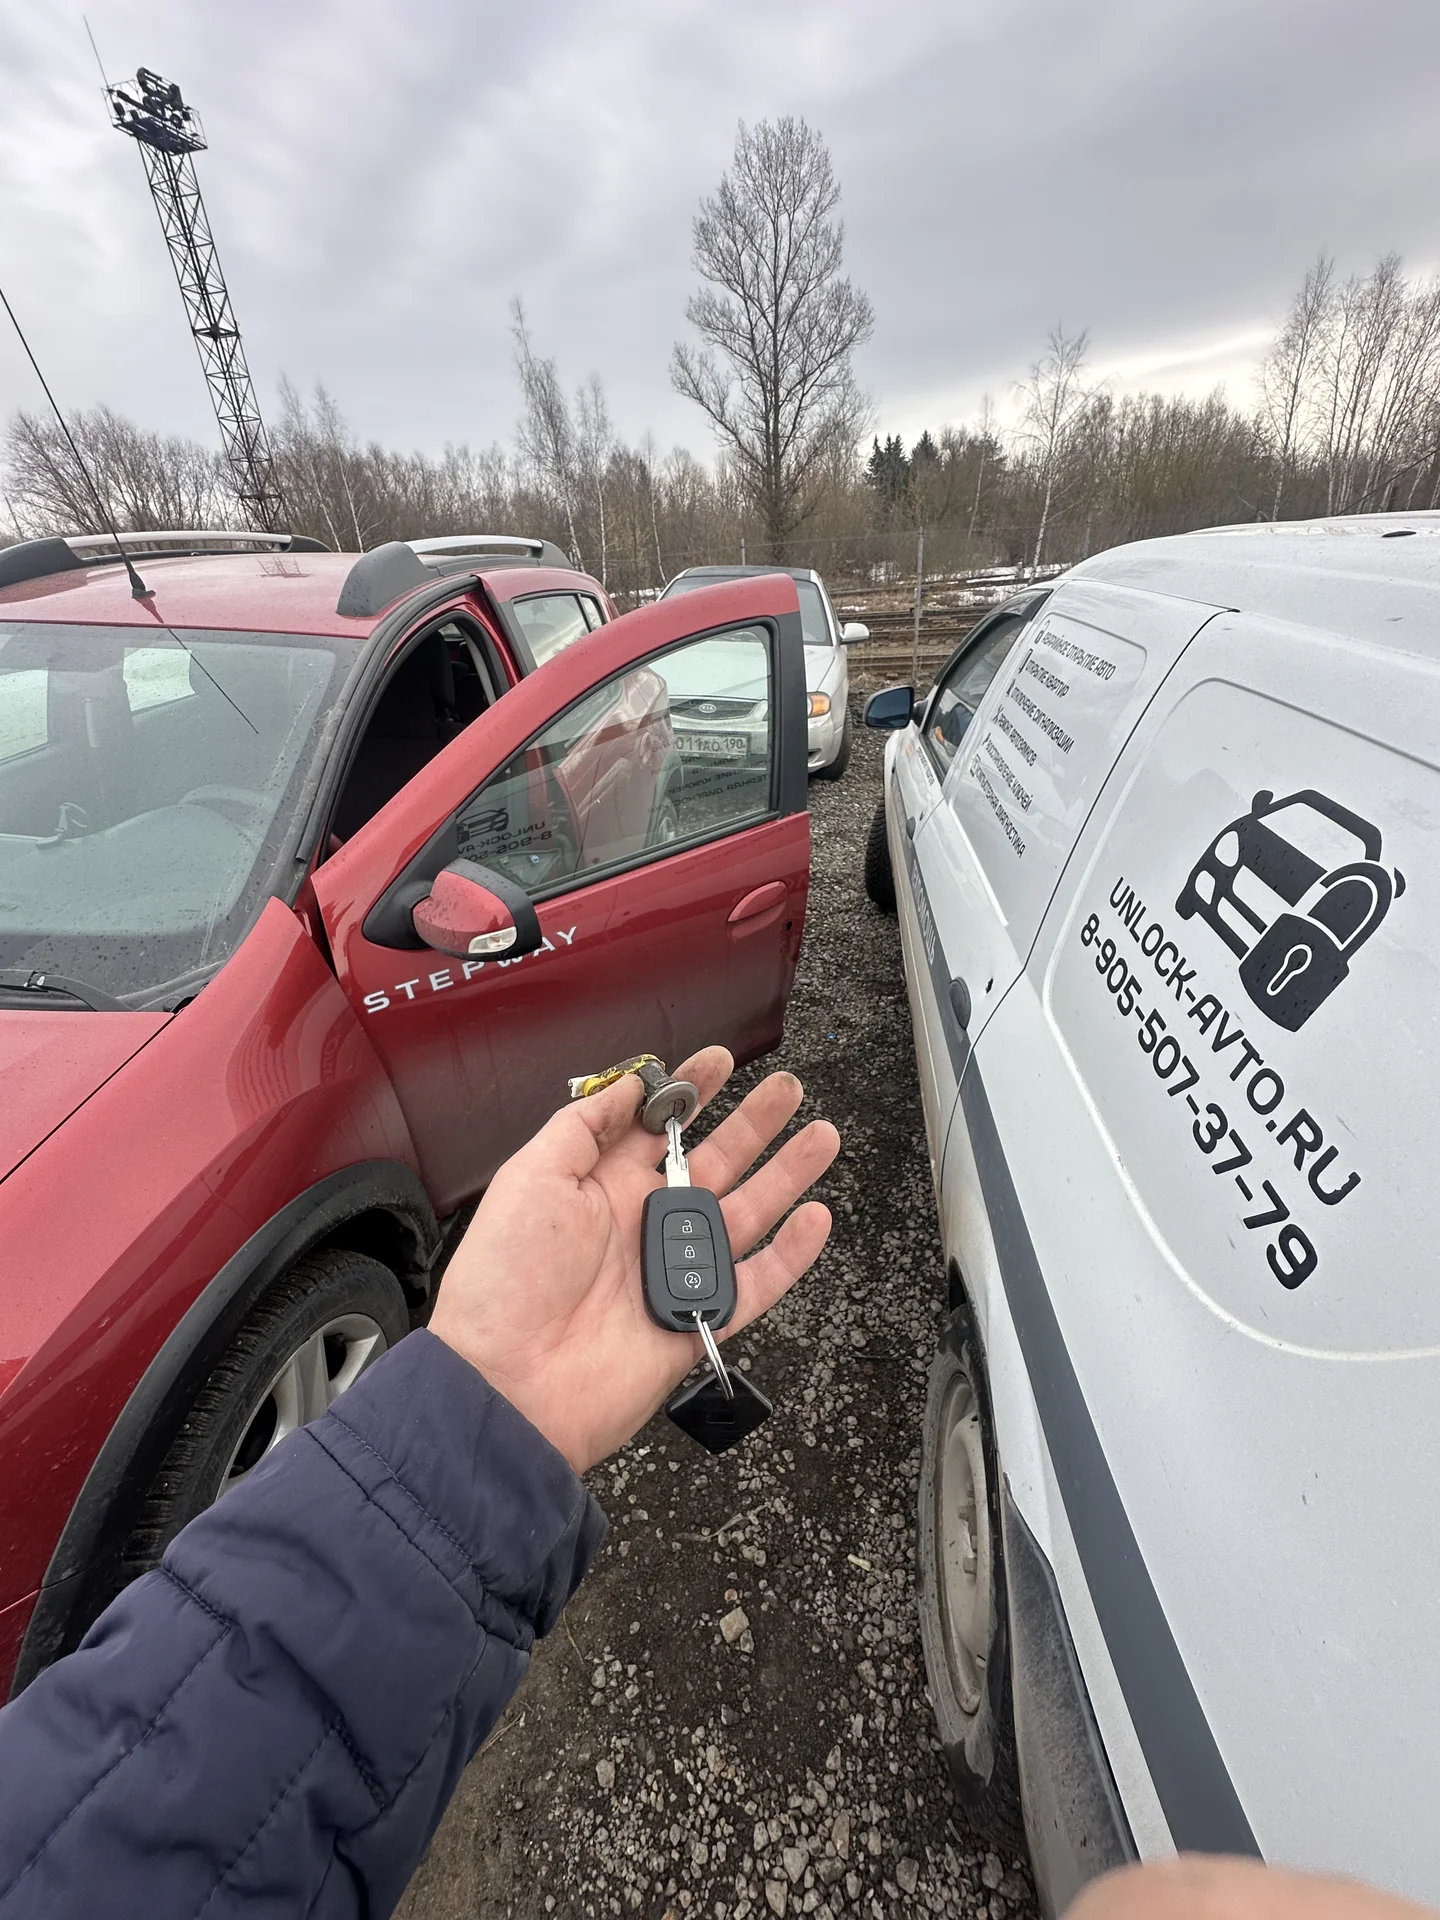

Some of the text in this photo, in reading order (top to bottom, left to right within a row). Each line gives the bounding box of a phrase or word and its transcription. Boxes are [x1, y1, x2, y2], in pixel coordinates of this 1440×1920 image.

[1025, 659, 1070, 698] ОТКРЫТИЕ КВАРТИР
[1065, 644, 1099, 672] ОТКРЫТИЕ
[1092, 659, 1116, 681] АВТО
[1010, 687, 1075, 754] ОТКЛЮЧЕНИЕ СИГНАЛИЗАЦИИ
[723, 738, 743, 749] 190
[1009, 728, 1037, 767] АВТОЗАМКОВ
[1011, 779, 1033, 812] КЛЮЧЕЙ
[995, 804, 1026, 859] ДИАГНОСТИКА
[1109, 877, 1362, 1206] UNLOCK-AVTO.RU
[1080, 912, 1319, 1290] 8-905-507-37-79
